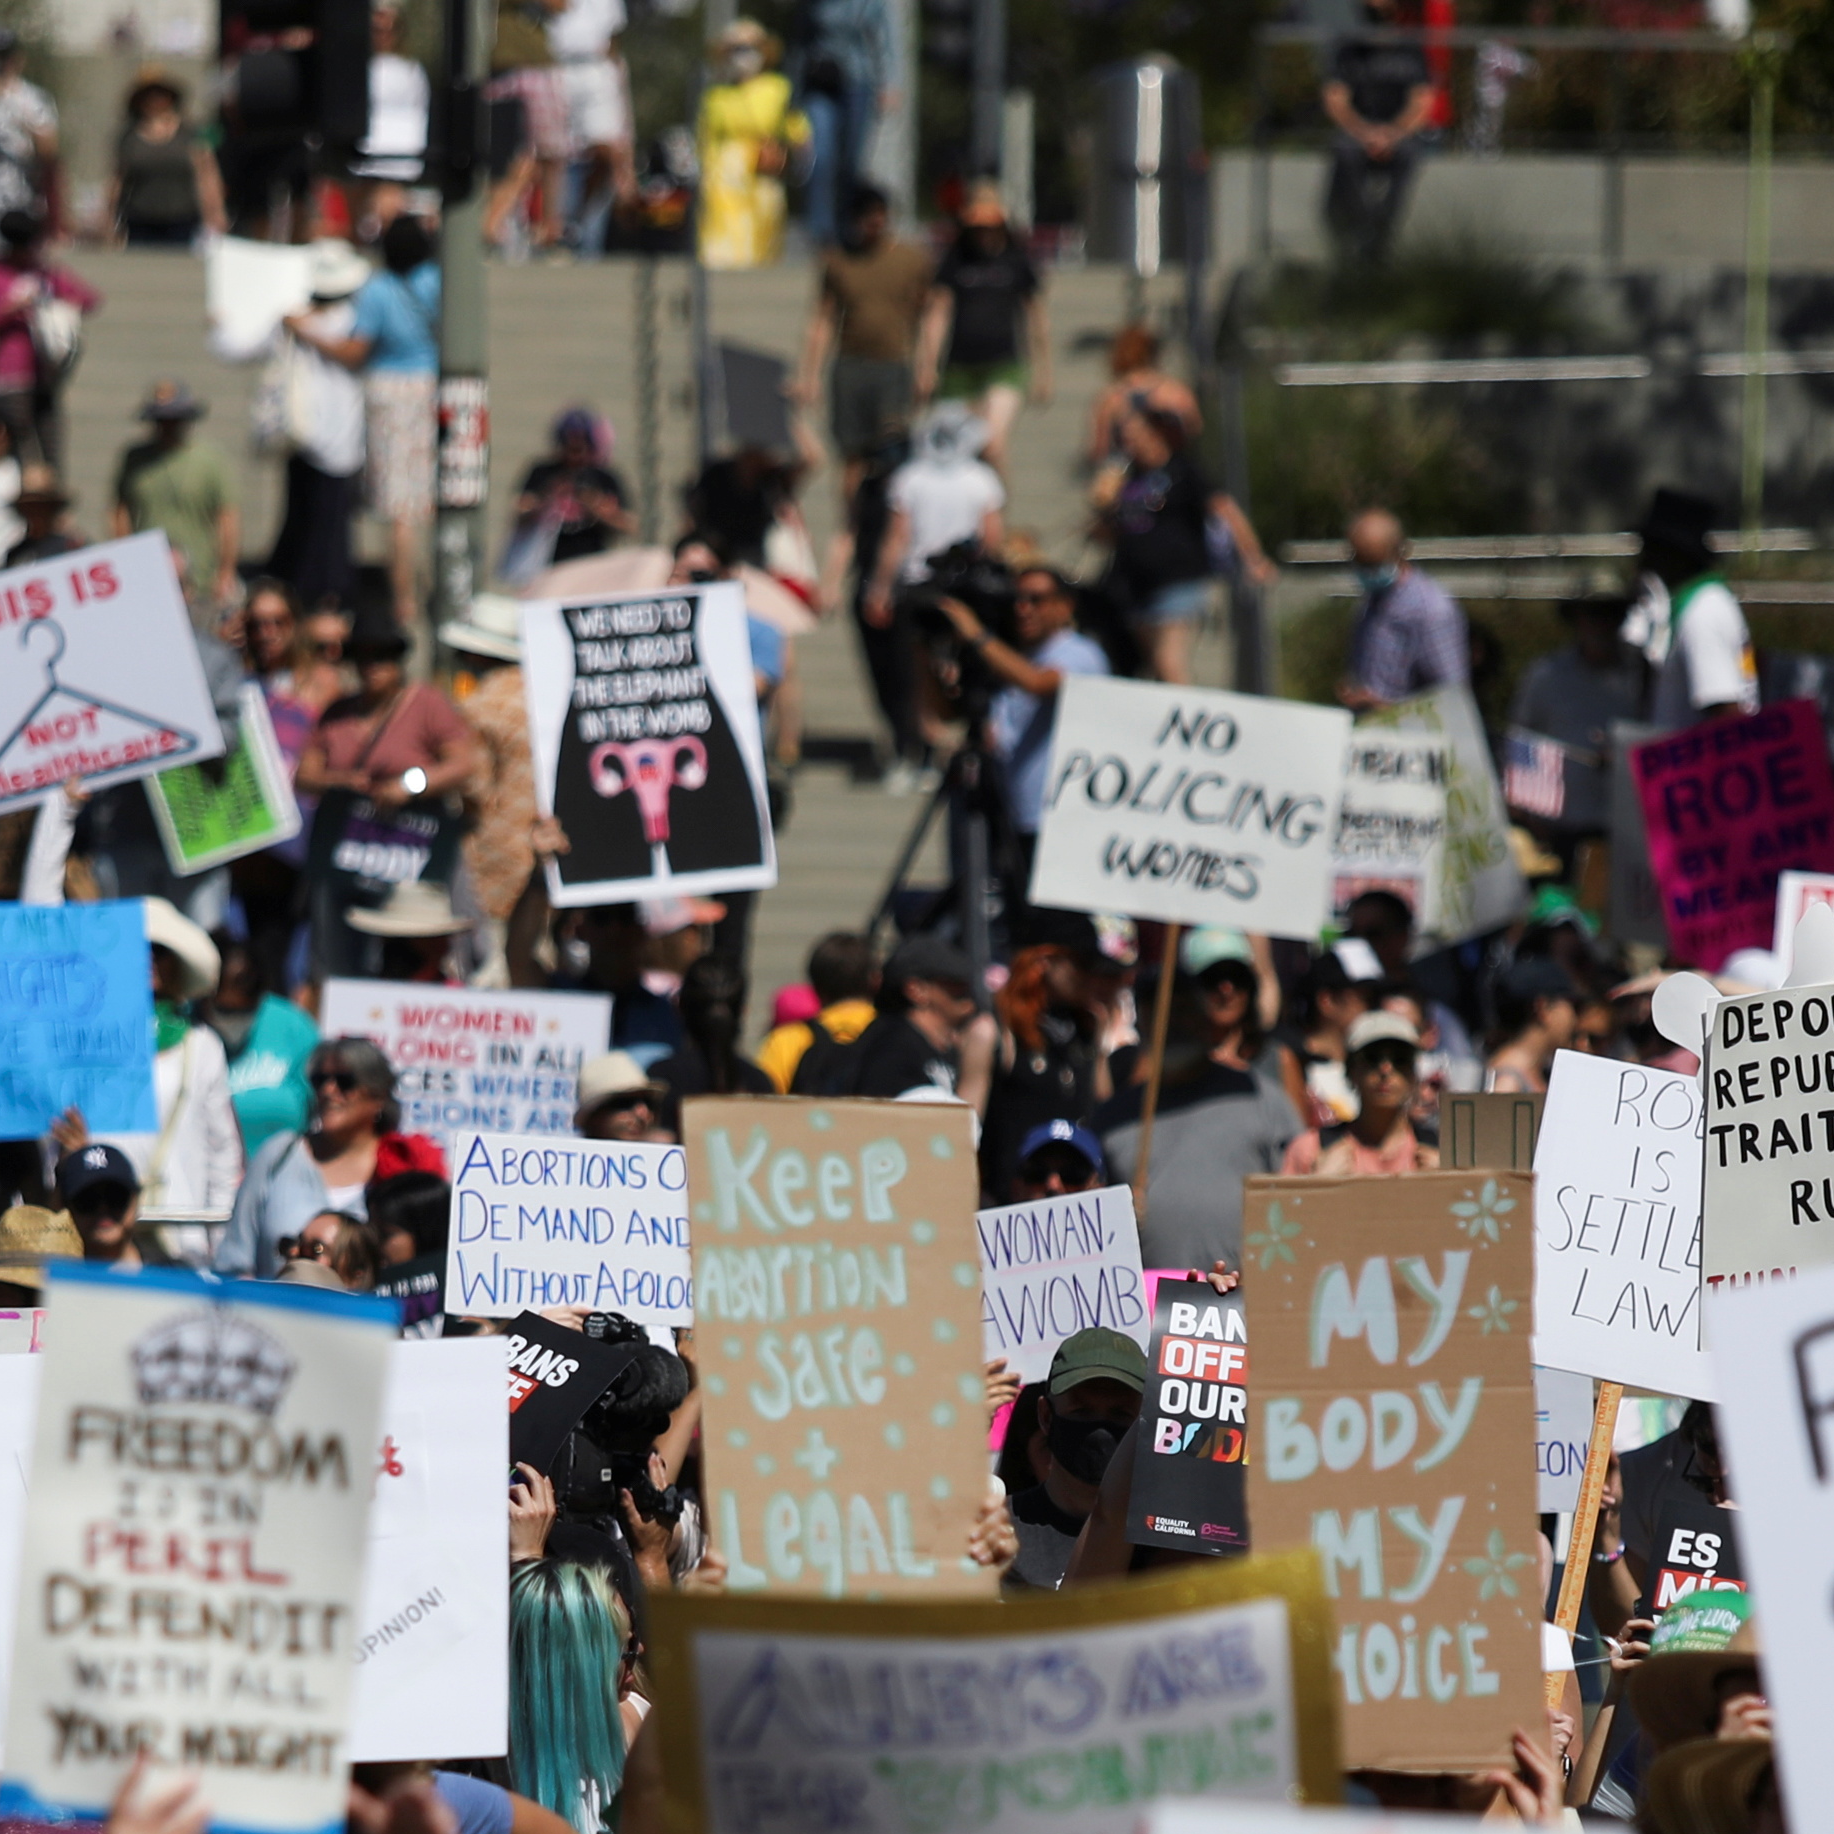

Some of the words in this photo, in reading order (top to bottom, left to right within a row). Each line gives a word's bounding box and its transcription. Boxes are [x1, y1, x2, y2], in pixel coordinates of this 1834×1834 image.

[70, 561, 121, 605] IS
[611, 601, 662, 636] NEED
[626, 632, 693, 669] ABOUT
[612, 664, 707, 705] ELEPHANT
[23, 708, 102, 749] NOT
[1154, 705, 1240, 757] NO
[1050, 749, 1326, 850] POLICING
[1661, 744, 1815, 836] ROE
[1101, 834, 1261, 903] WOMBS
[396, 1006, 538, 1037] WOMEN
[489, 1043, 526, 1069] IN
[457, 1135, 648, 1190] ABORTIONS
[1631, 1146, 1677, 1195] IS
[458, 1190, 615, 1244] DEMAND
[625, 1208, 691, 1248] AND
[975, 1197, 1117, 1273] WOMAN,
[457, 1249, 593, 1308] WITHOUT
[999, 1264, 1146, 1347] WOMB
[1572, 1267, 1704, 1337] LAW
[1311, 1249, 1472, 1369] MY
[506, 1333, 581, 1388] BANS
[1164, 1338, 1244, 1384] OFF
[1158, 1378, 1247, 1424] OUR
[67, 1405, 353, 1490] FREEDOM
[1264, 1376, 1484, 1485] BODY
[1154, 1524, 1196, 1537] CALIFORNIA
[1155, 1516, 1190, 1529] EQUALITY
[1311, 1496, 1468, 1603] MY
[1666, 1527, 1723, 1569] ES
[87, 1520, 289, 1590] PERIL
[46, 1573, 270, 1657] DEFEND
[282, 1600, 348, 1657] IT
[73, 1653, 214, 1700] WITH
[227, 1662, 324, 1710] ALL
[46, 1703, 167, 1770] YOUR
[181, 1720, 345, 1777] MIGHT
